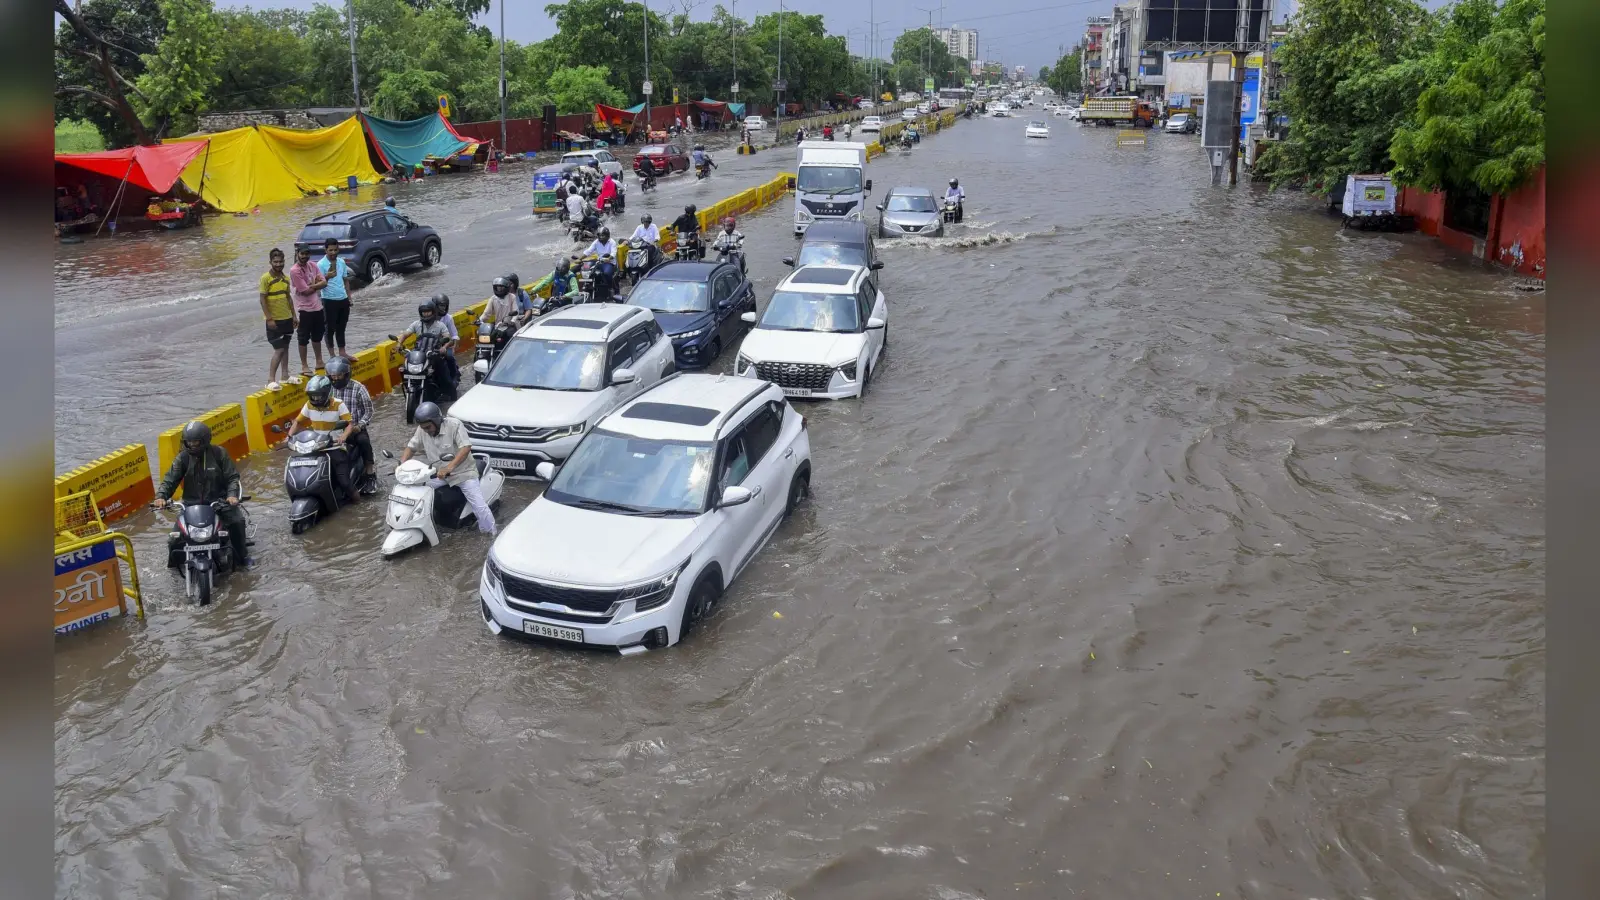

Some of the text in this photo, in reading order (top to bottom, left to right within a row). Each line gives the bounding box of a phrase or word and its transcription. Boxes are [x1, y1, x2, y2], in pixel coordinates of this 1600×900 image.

[78, 455, 146, 492] JAIPUR TRAFFIC POLICE
[89, 482, 107, 494] OLLOW
[104, 499, 122, 513] kotak
[529, 624, 540, 634] HR
[541, 626, 552, 636] 98
[553, 628, 559, 638] B
